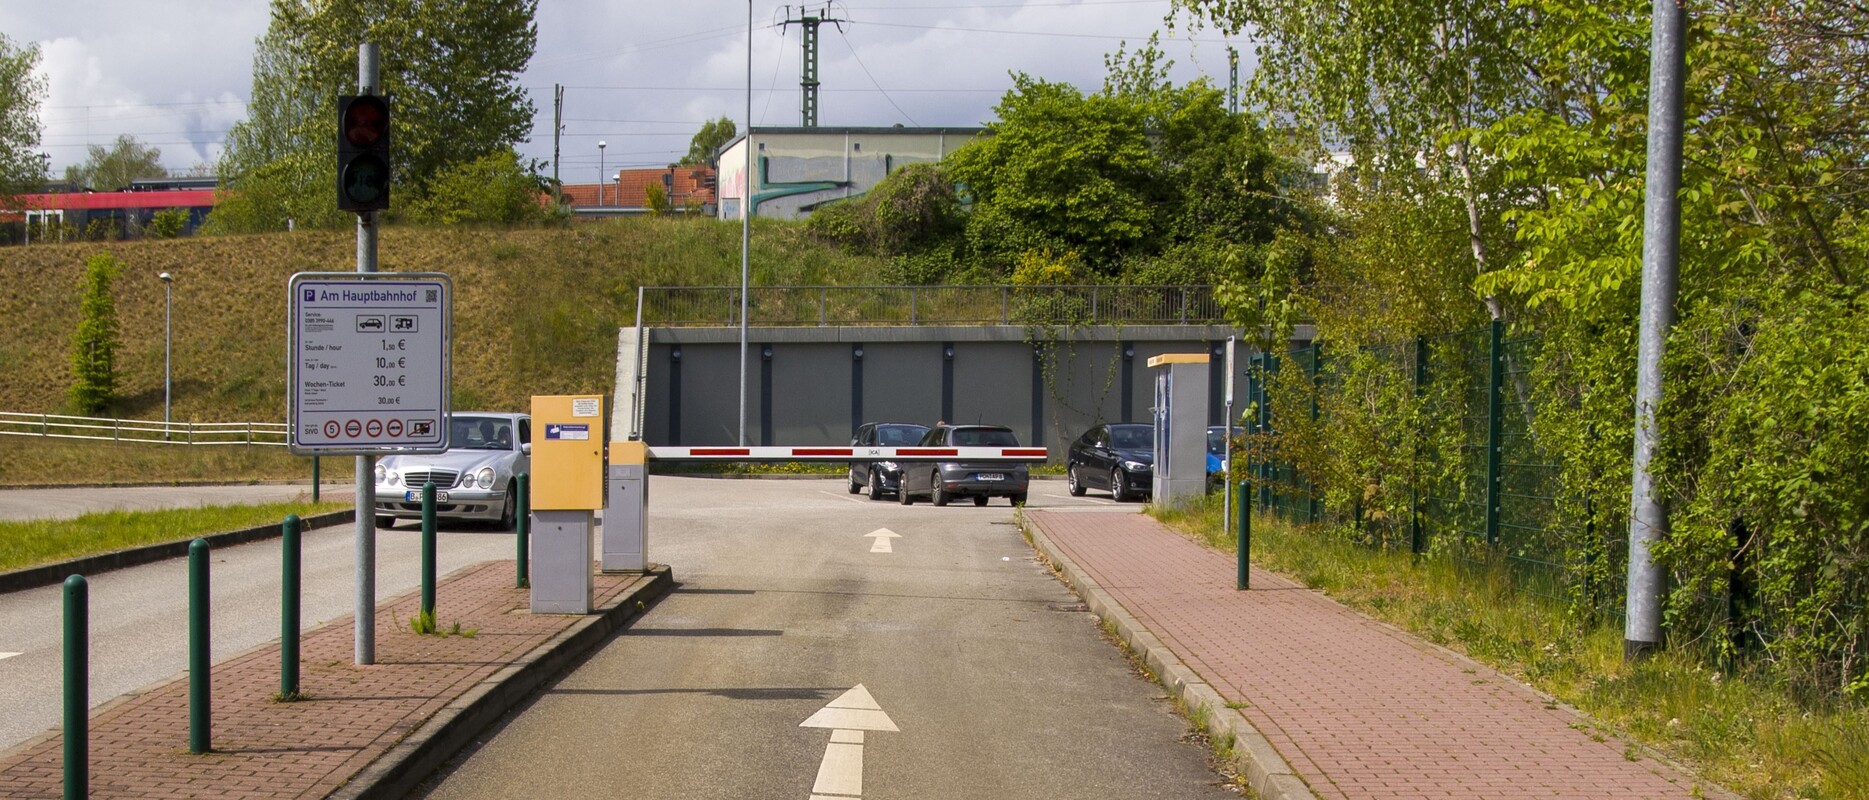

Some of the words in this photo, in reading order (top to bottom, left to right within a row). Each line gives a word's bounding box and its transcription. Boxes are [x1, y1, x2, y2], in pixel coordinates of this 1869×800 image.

[320, 290, 339, 301] Am
[342, 289, 417, 304] Hauptbahnhof
[381, 339, 396, 351] 1,50
[398, 339, 406, 351] €
[305, 362, 315, 370] Tag
[319, 362, 330, 370] day
[375, 357, 396, 369] 10,00
[398, 357, 406, 369] €
[373, 375, 396, 387] 30,00
[398, 375, 406, 387] €
[329, 425, 335, 433] 5
